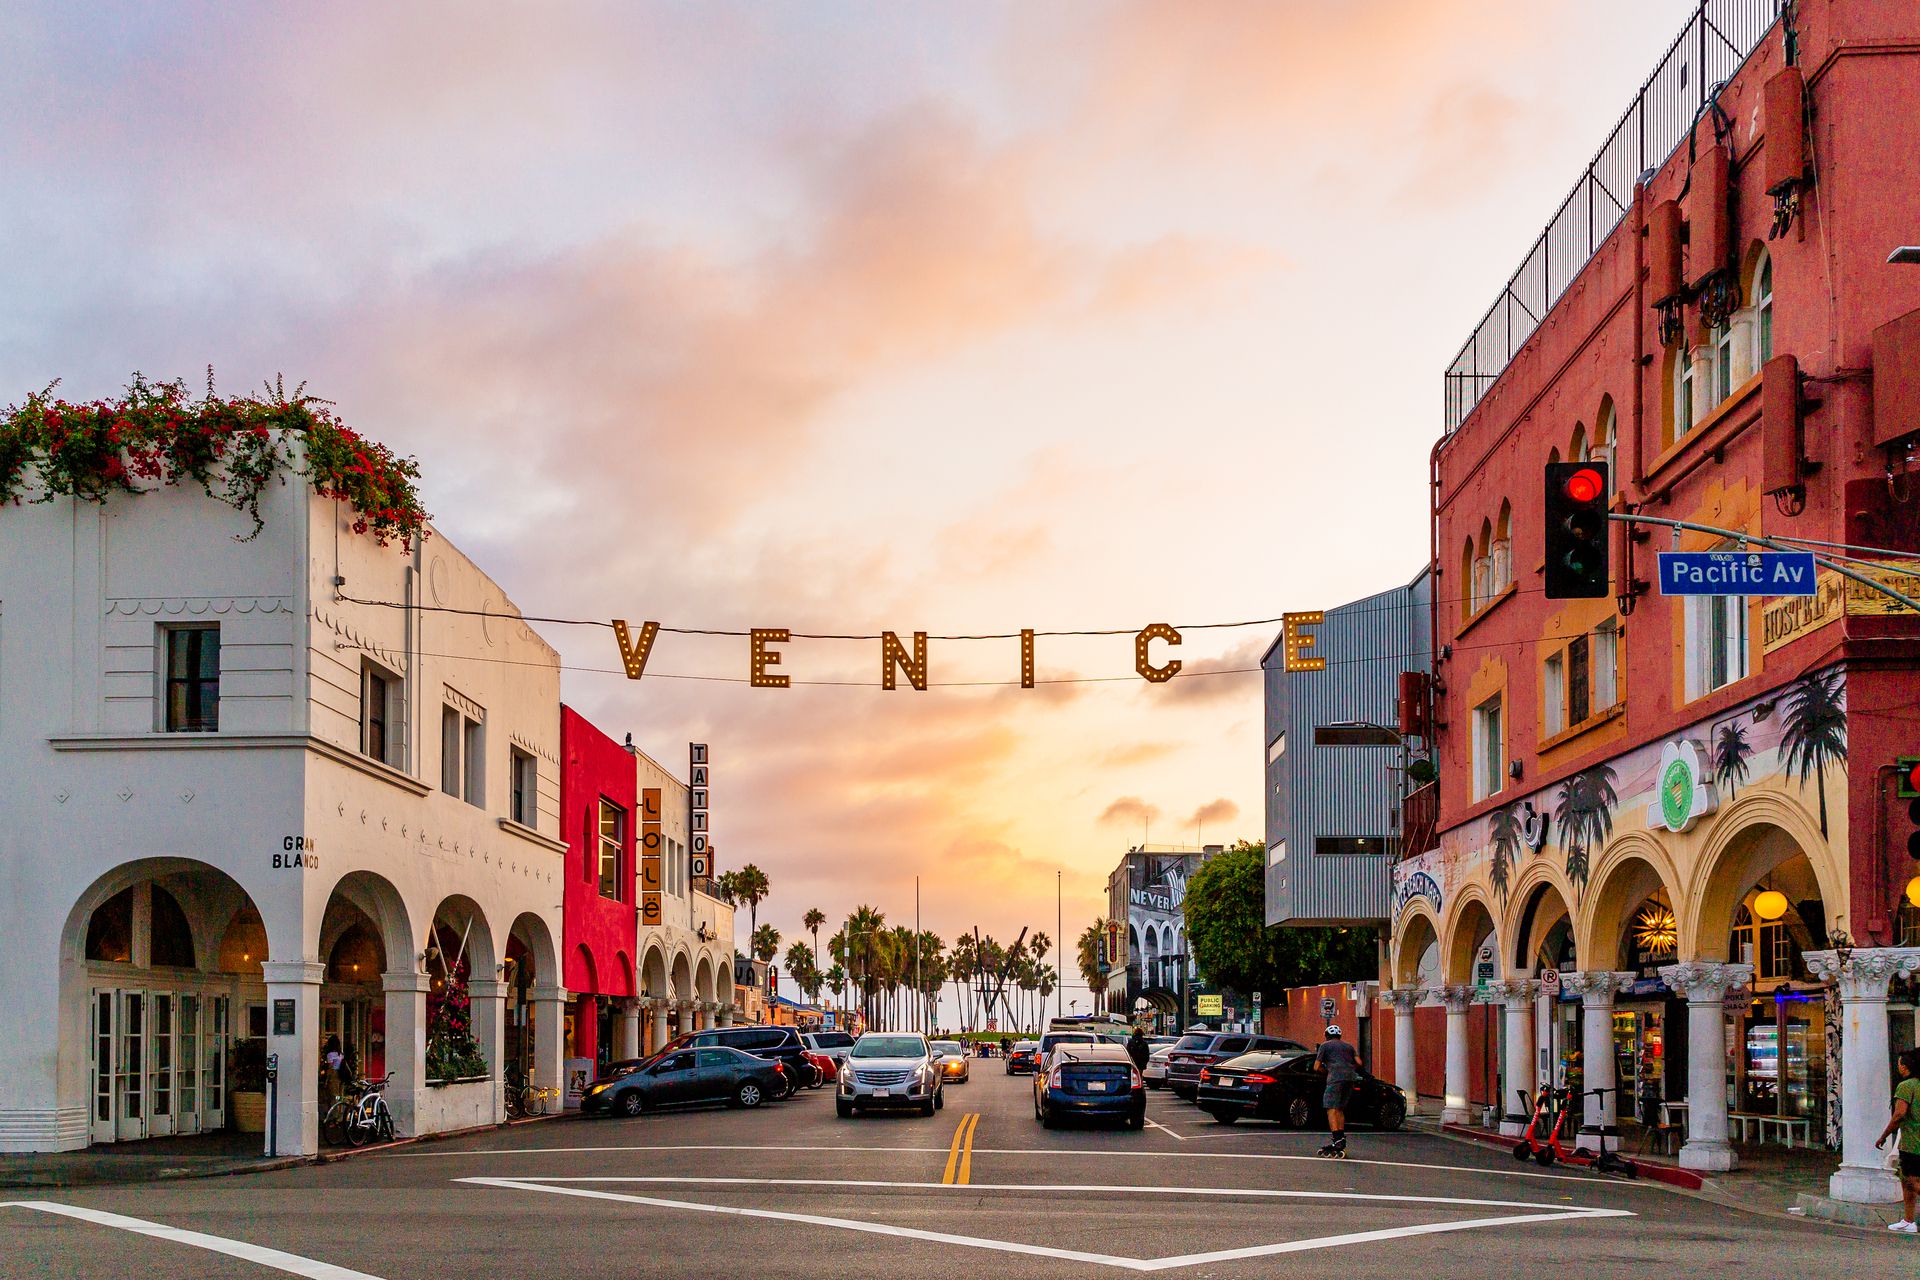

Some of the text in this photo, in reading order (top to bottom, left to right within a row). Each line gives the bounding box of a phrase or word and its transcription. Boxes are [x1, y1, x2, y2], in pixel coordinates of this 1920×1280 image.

[1673, 561, 1804, 583] Pacific Av
[1763, 584, 1825, 646] HOSTEL
[611, 610, 1325, 691] VENICE
[693, 746, 705, 874] TATTOO
[283, 835, 315, 852] GRAN
[272, 853, 319, 869] BLANCO
[1130, 888, 1169, 910] NEVER
